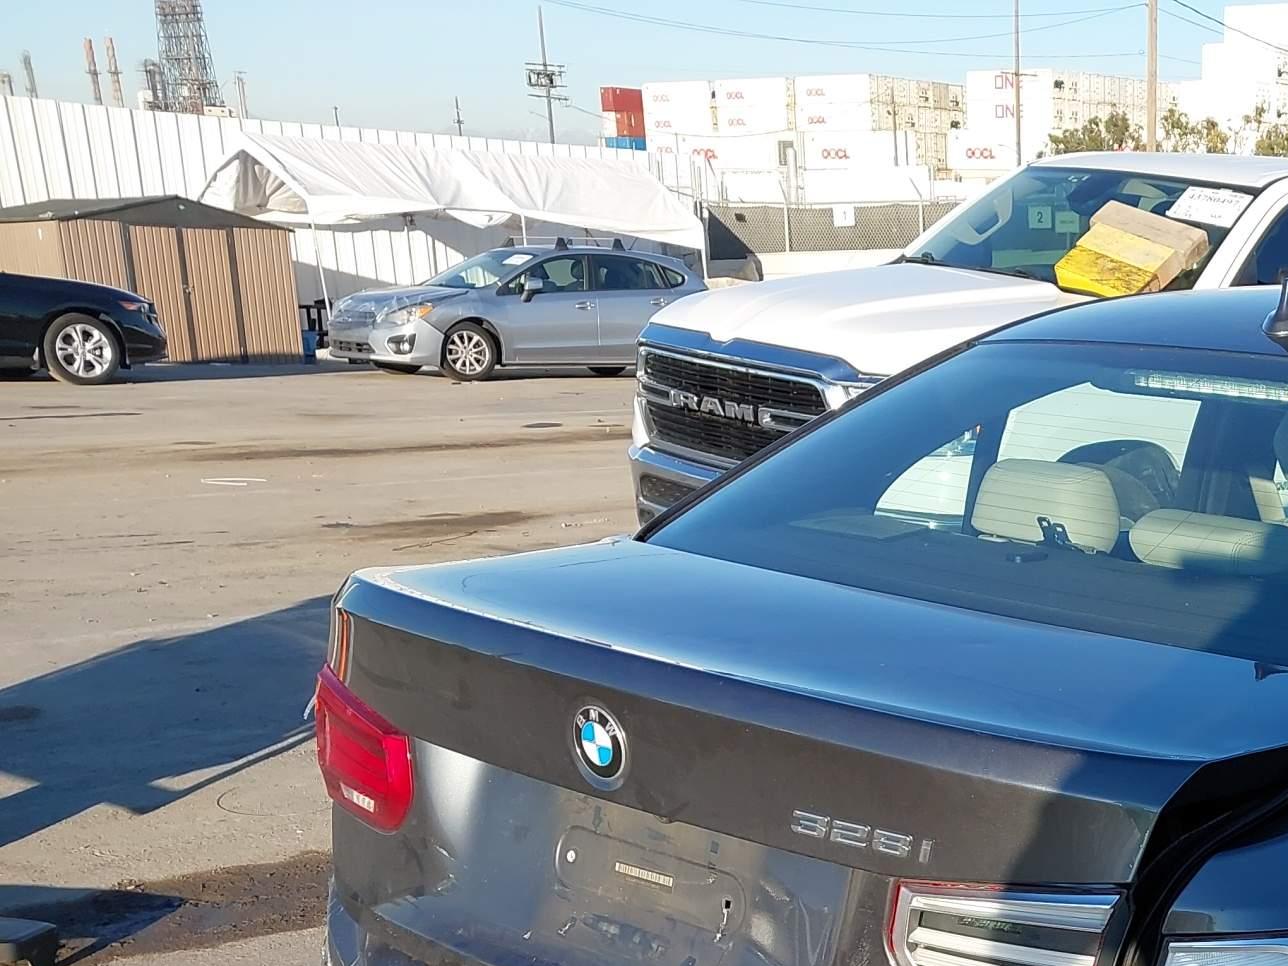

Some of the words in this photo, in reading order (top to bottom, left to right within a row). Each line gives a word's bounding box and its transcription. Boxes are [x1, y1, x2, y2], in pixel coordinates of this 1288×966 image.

[821, 148, 851, 160] OOCL
[965, 147, 996, 160] OOCL
[1036, 211, 1044, 224] 2
[679, 389, 755, 423] RAM
[576, 709, 617, 737] BMW
[790, 809, 936, 864] 328i
